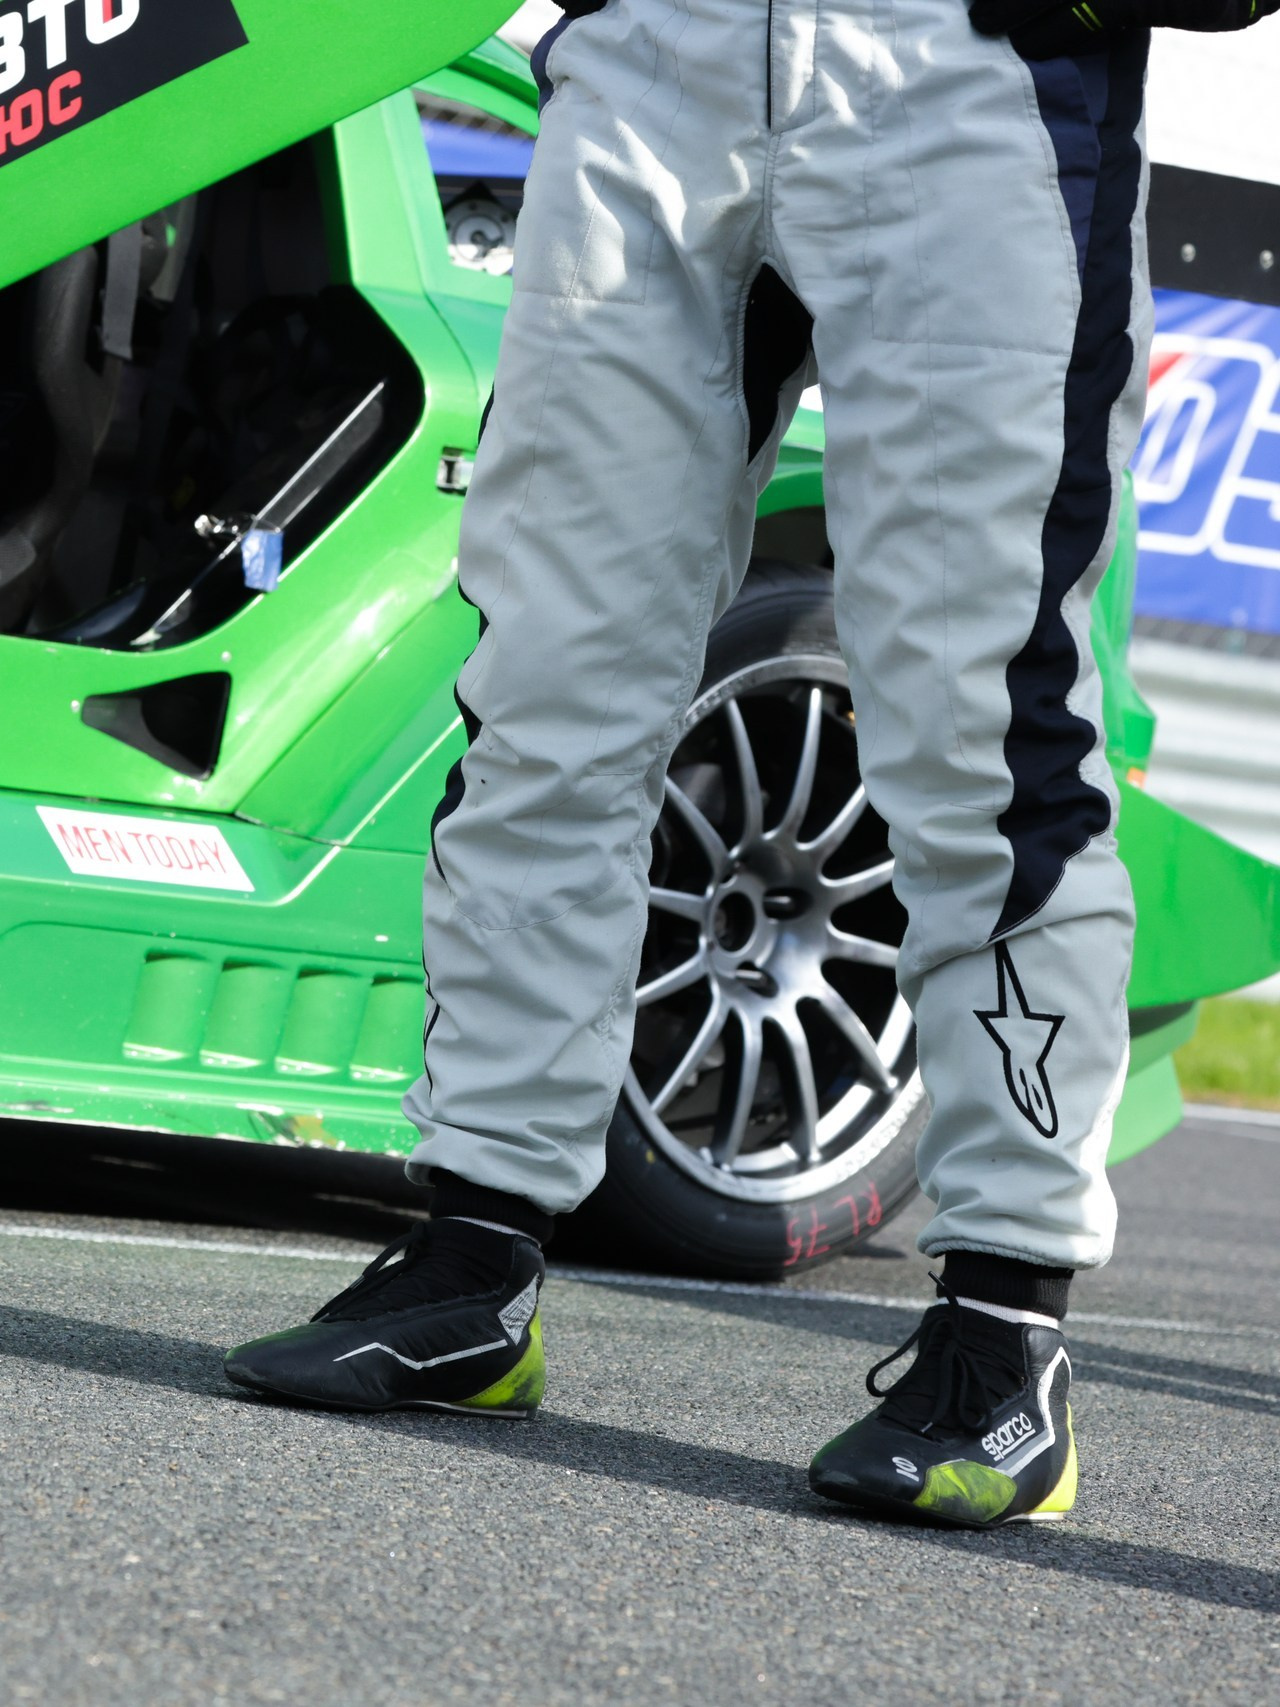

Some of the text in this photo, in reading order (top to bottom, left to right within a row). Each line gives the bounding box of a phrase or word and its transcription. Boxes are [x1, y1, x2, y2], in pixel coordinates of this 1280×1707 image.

[57, 823, 227, 874] MEN TODAY
[982, 1412, 1033, 1460] sparco
